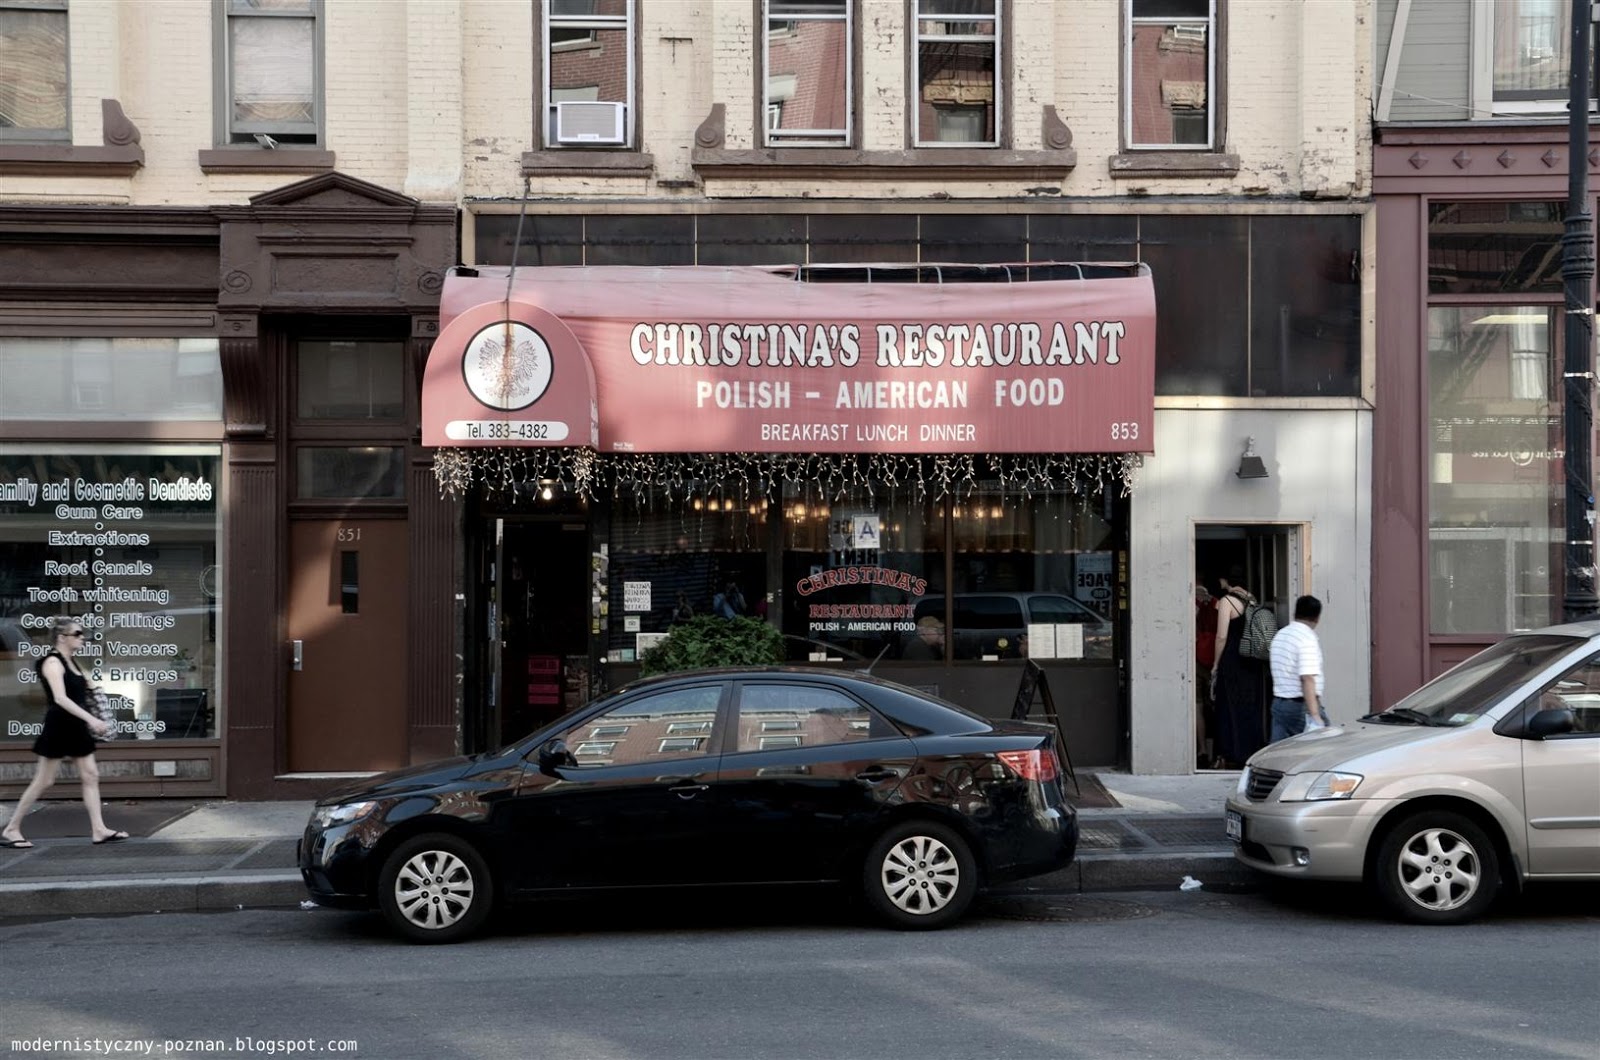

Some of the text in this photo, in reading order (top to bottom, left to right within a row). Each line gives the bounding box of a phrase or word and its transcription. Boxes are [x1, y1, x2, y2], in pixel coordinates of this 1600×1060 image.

[630, 320, 1125, 368] CHRISTINA'S RESTAURANT
[696, 381, 791, 409] POLISH
[835, 380, 968, 409] AMERICAN
[995, 378, 1064, 407] FOOD
[466, 423, 548, 439] Tel. 383-4382
[761, 424, 976, 441] BREAKFAST LUNCH DINNER
[1111, 423, 1139, 440] 853
[0, 477, 212, 506] amily and Cosmetic Dentists
[55, 504, 143, 519] Gum Care
[48, 531, 150, 546] Extractions
[337, 528, 361, 541] 851
[859, 521, 875, 539] A
[45, 560, 153, 575] Root Canals
[797, 566, 927, 597] CHRISTINA'S
[27, 587, 169, 605] Tooth whitening
[809, 603, 917, 618] RESTAURANT
[21, 613, 175, 631] Cosetic Fillings
[809, 622, 840, 631] POLISH
[847, 622, 892, 631] AMERICAN
[893, 622, 916, 631] FOOD
[106, 641, 178, 656] Veneers
[92, 668, 178, 685] & Bridges
